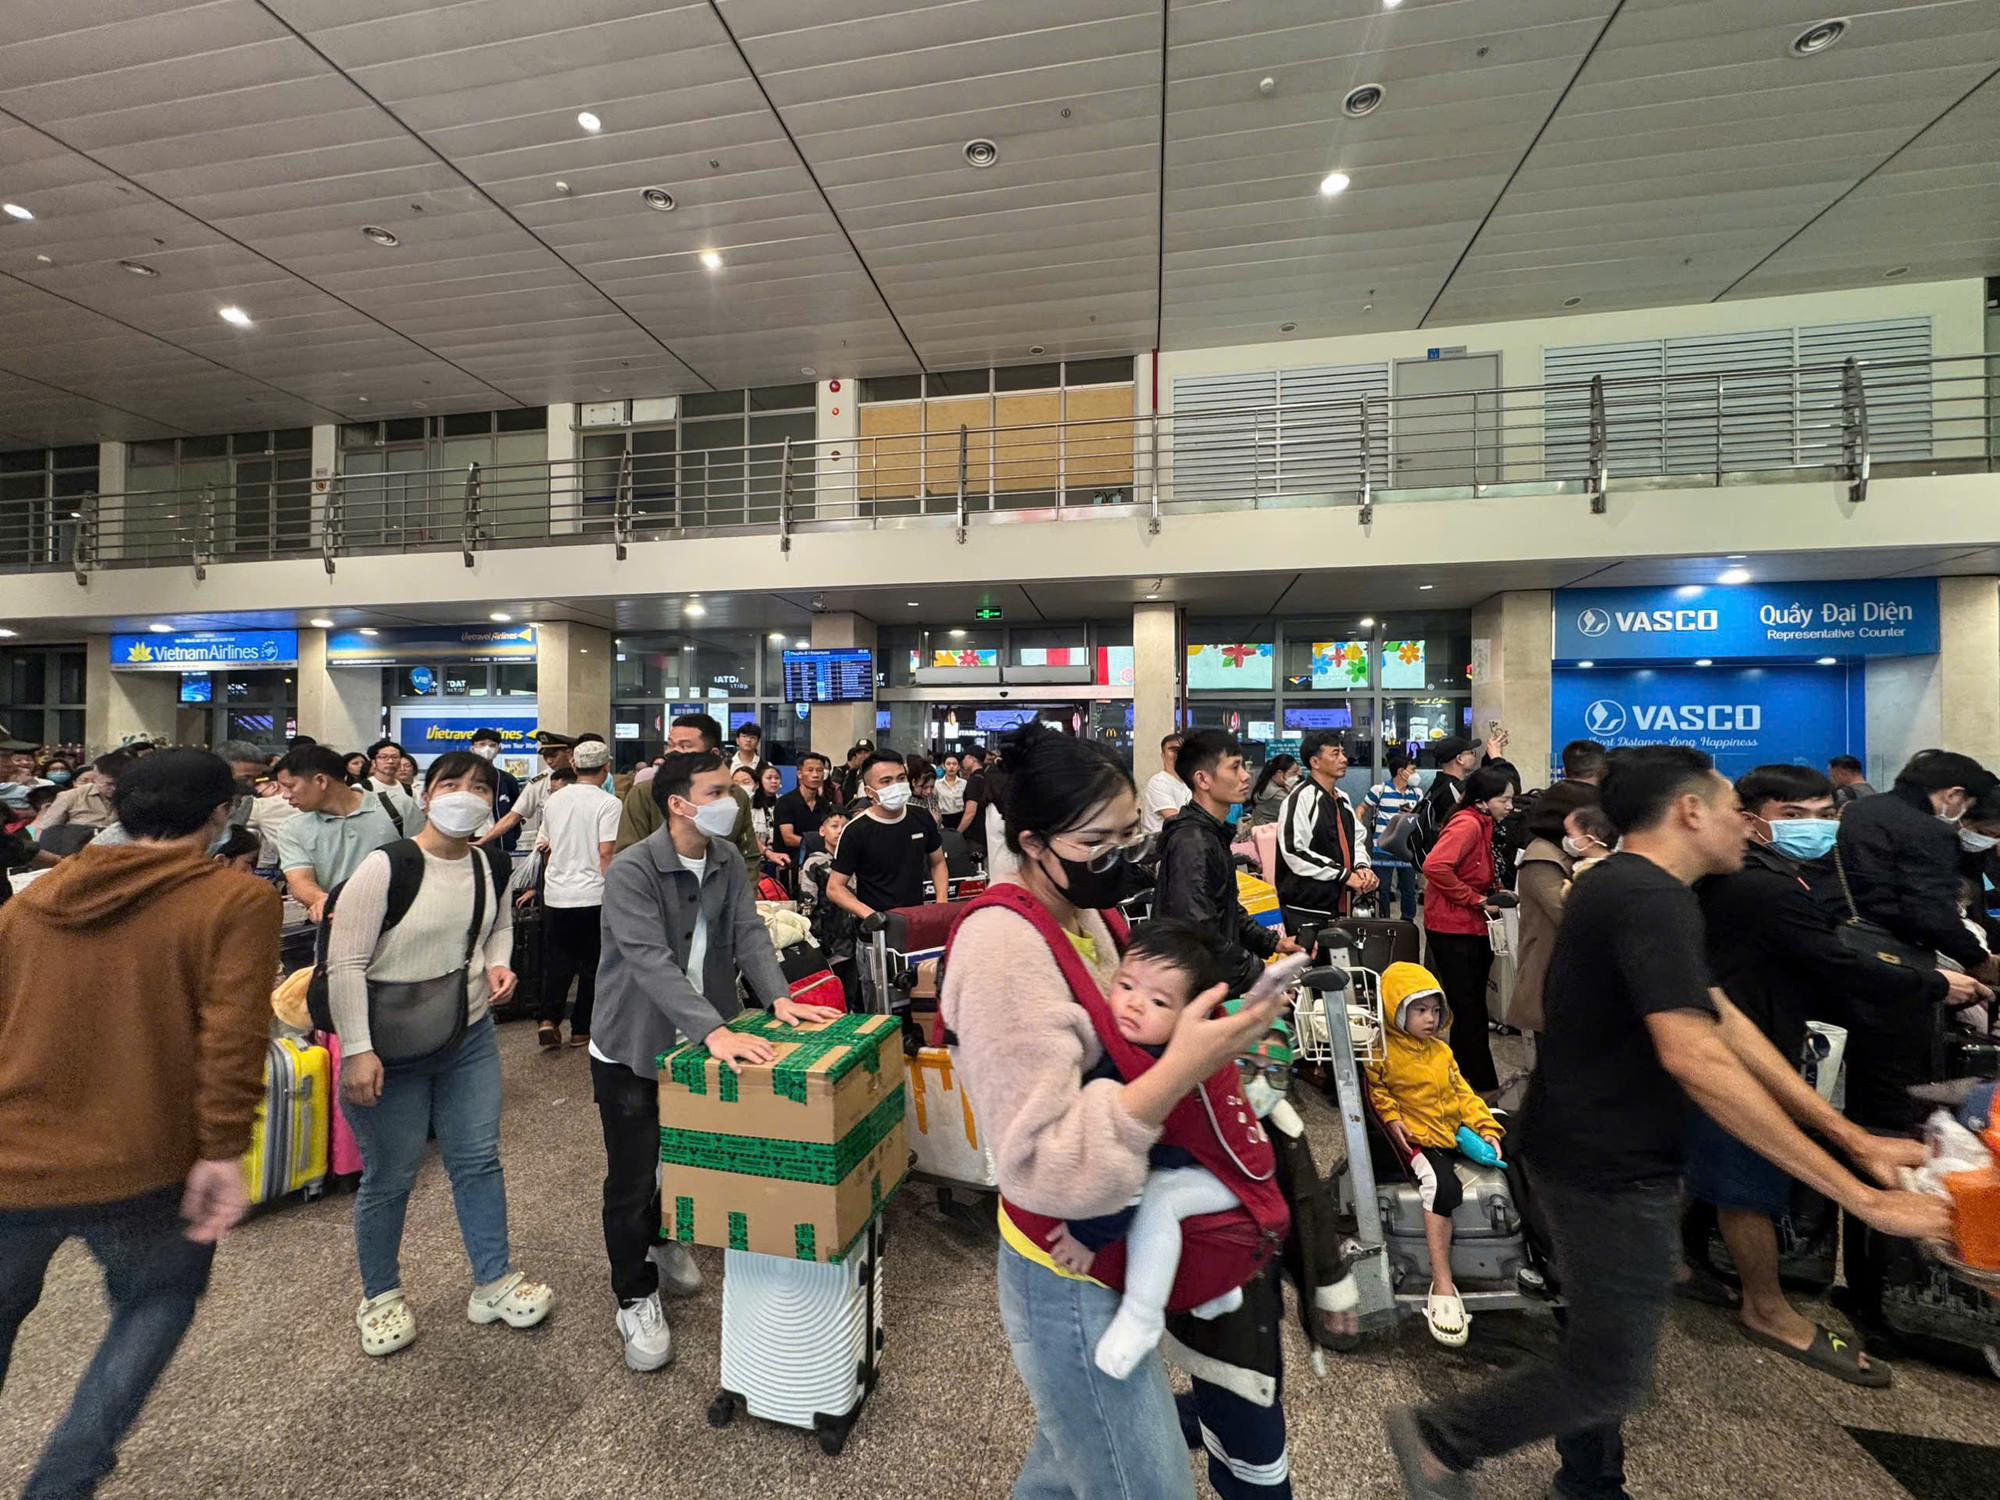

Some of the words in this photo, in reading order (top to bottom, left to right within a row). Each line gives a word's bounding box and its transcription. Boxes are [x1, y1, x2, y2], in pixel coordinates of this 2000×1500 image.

[1614, 609, 1718, 632] VASCO
[1759, 602, 1814, 629] Quầy
[1821, 603, 1856, 626] Đại
[1863, 601, 1913, 625] Diện
[1767, 629, 1855, 642] Representative
[1859, 627, 1906, 638] Counter
[1631, 705, 1761, 731] VASCO
[1700, 736, 1758, 750] Happiness
